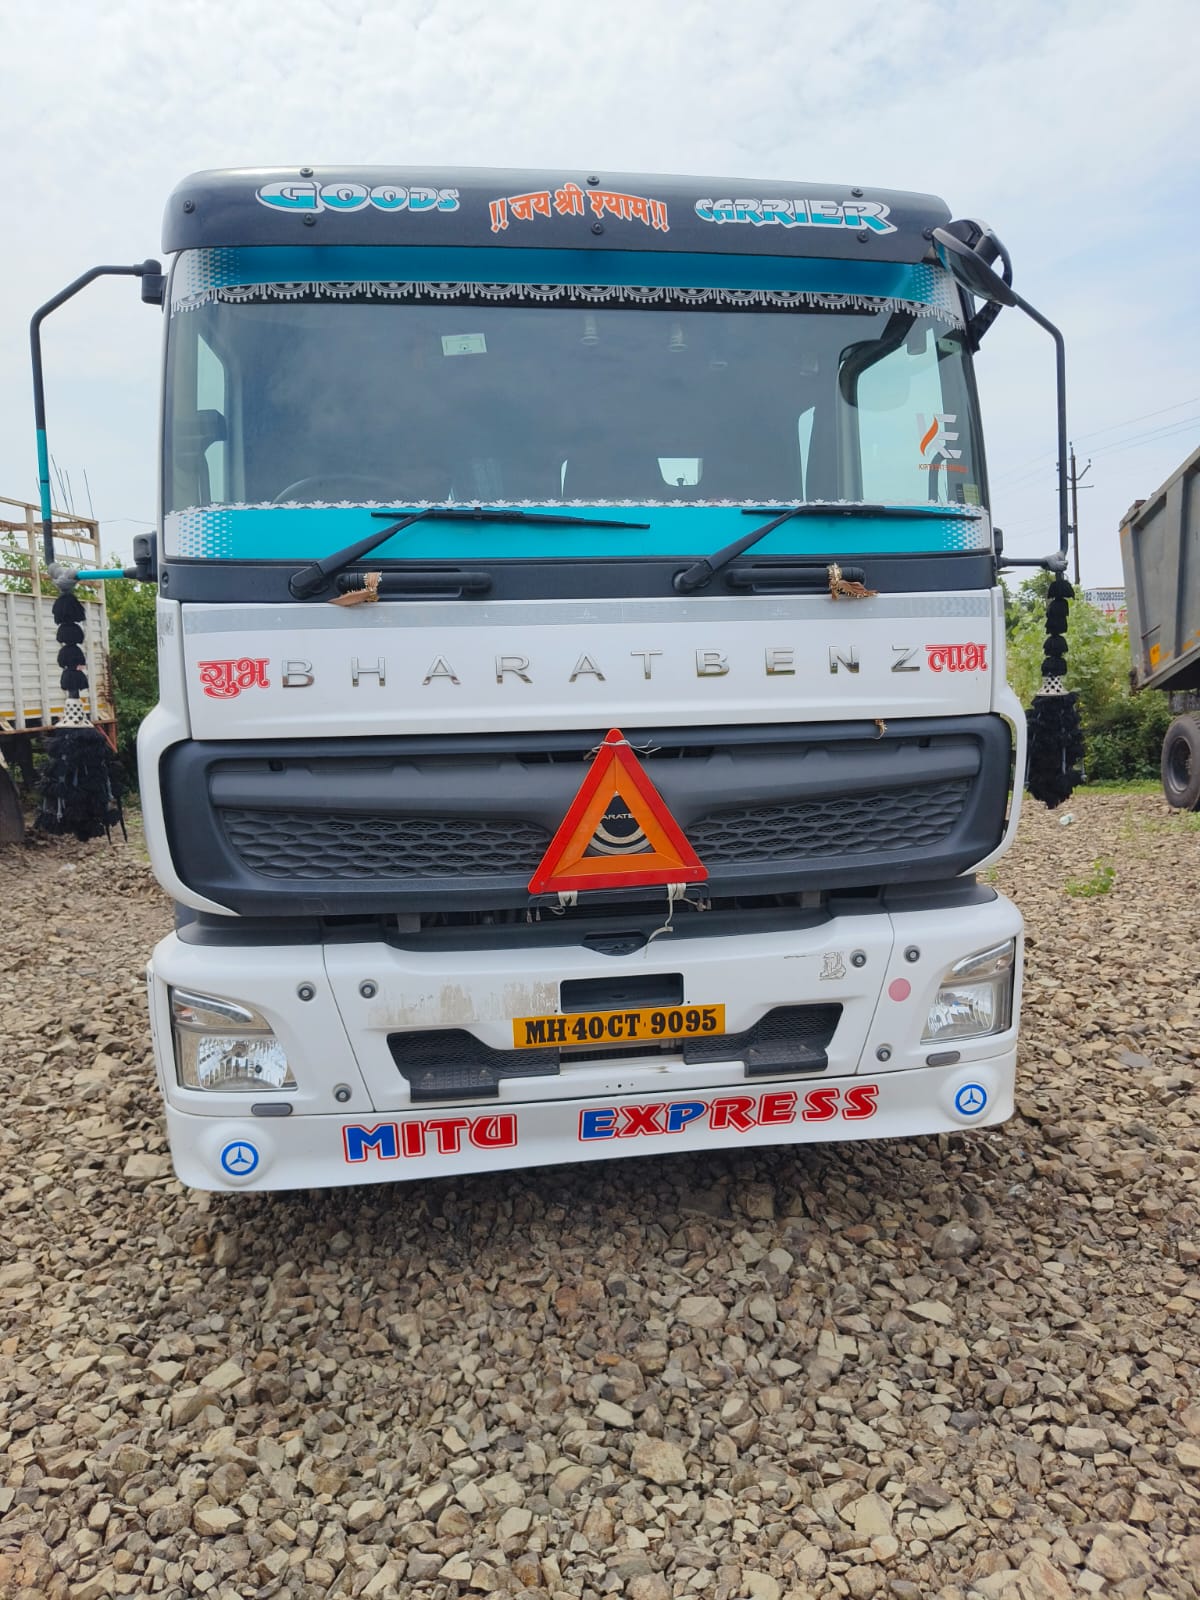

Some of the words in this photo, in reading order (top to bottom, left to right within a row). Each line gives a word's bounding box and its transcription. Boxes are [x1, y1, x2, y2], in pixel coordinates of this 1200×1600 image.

[255, 181, 460, 213] GOODS
[553, 182, 585, 216] श्री
[694, 198, 898, 235] CARRIER
[281, 644, 921, 688] BHARATBENZ
[925, 642, 988, 672] लाभ
[197, 656, 270, 699] शुभ
[342, 1113, 518, 1163] MITU
[578, 1084, 880, 1142] EXPRESS
